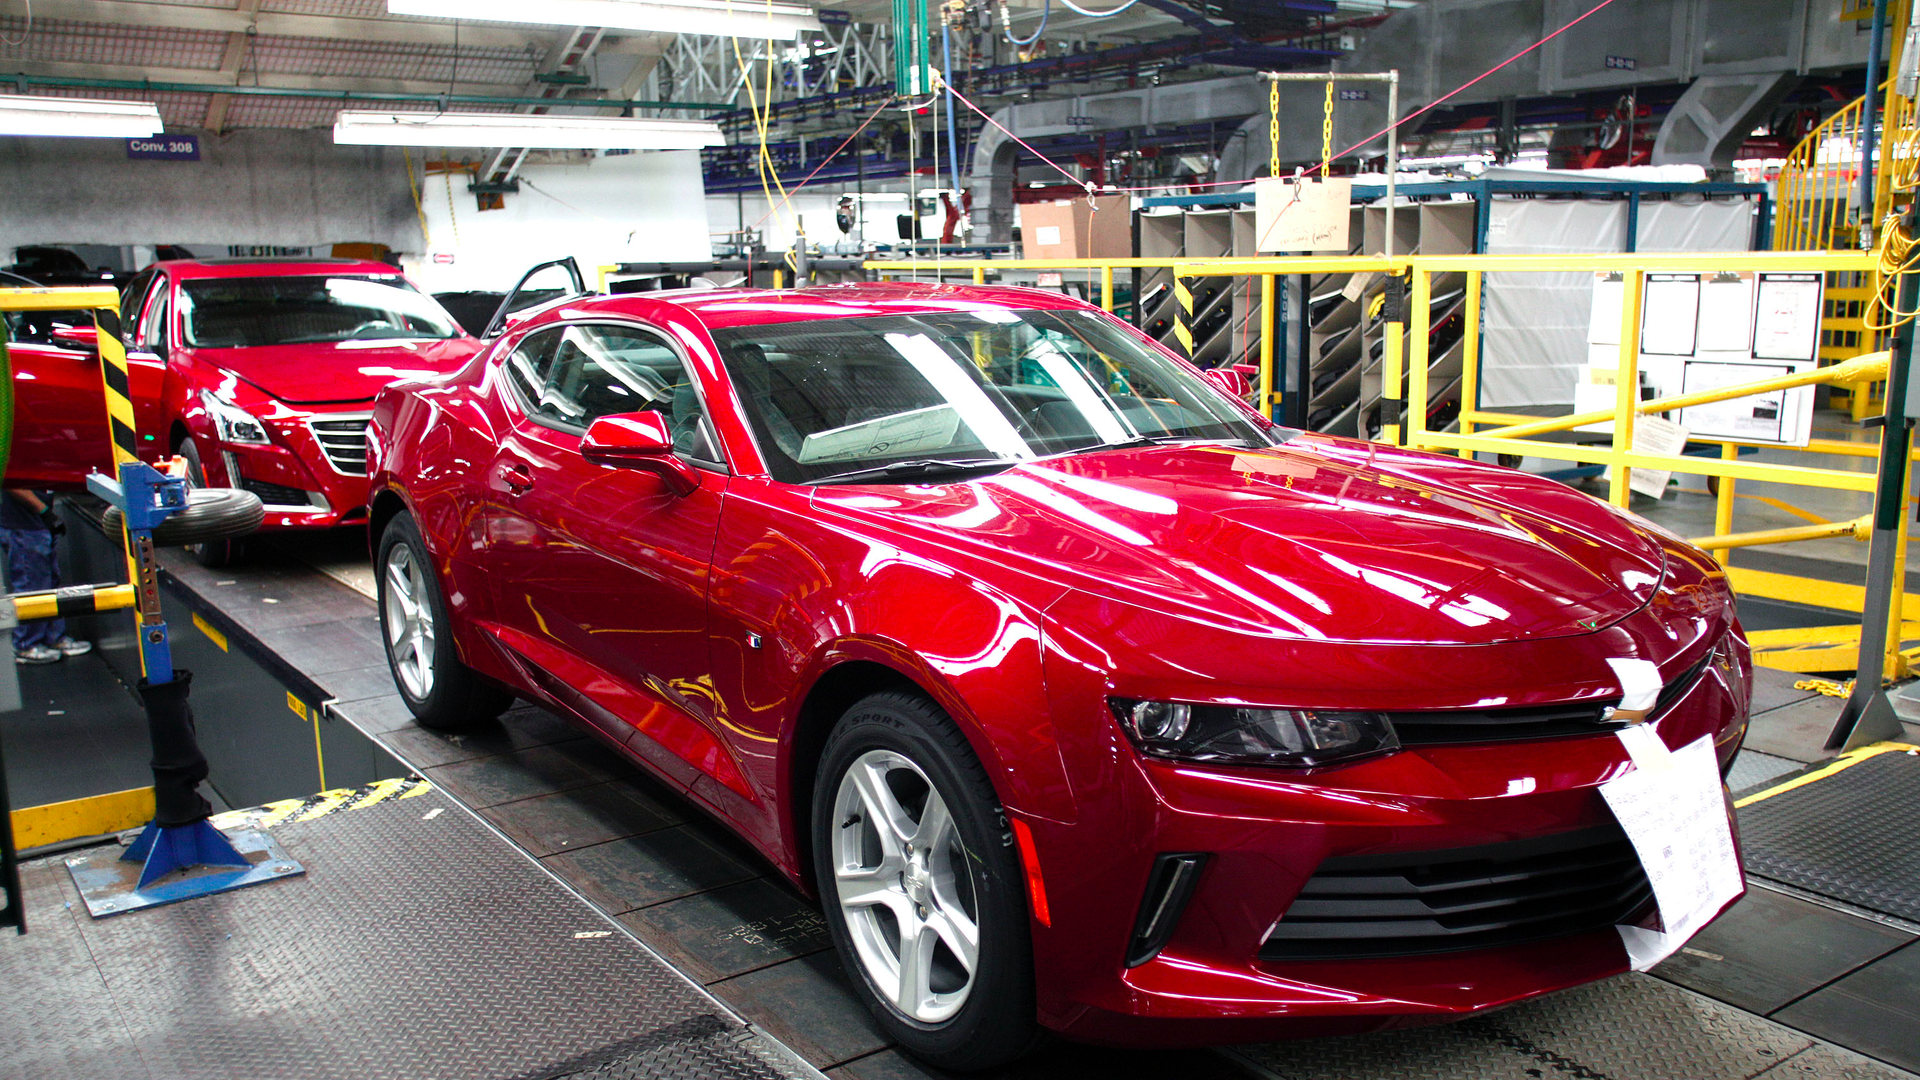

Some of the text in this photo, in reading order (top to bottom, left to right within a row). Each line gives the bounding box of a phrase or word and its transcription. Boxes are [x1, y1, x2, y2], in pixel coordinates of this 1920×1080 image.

[130, 140, 194, 154] Conv. 308
[851, 712, 906, 729] SPORT
